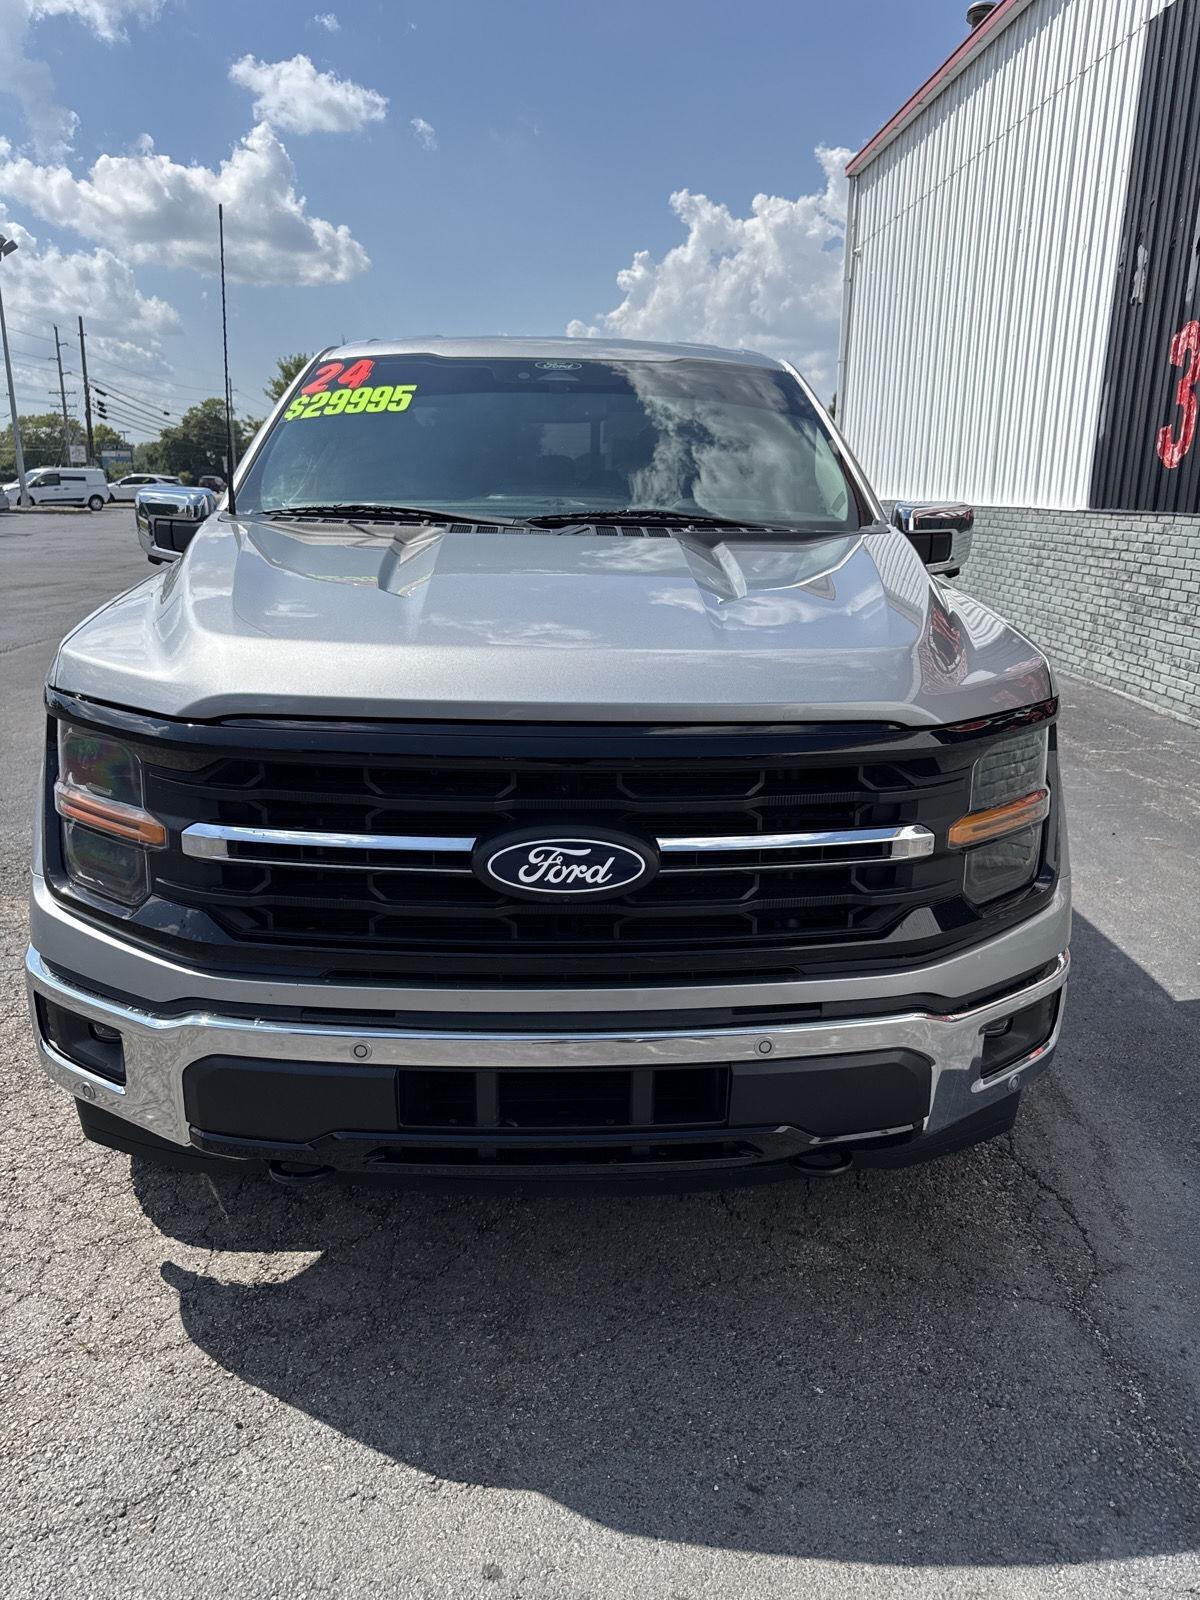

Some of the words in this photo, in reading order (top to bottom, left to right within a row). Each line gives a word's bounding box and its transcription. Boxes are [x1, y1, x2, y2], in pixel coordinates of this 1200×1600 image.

[302, 359, 375, 395] 24
[1157, 320, 1200, 469] 3
[283, 384, 418, 422] $29995
[518, 846, 616, 884] Ford
